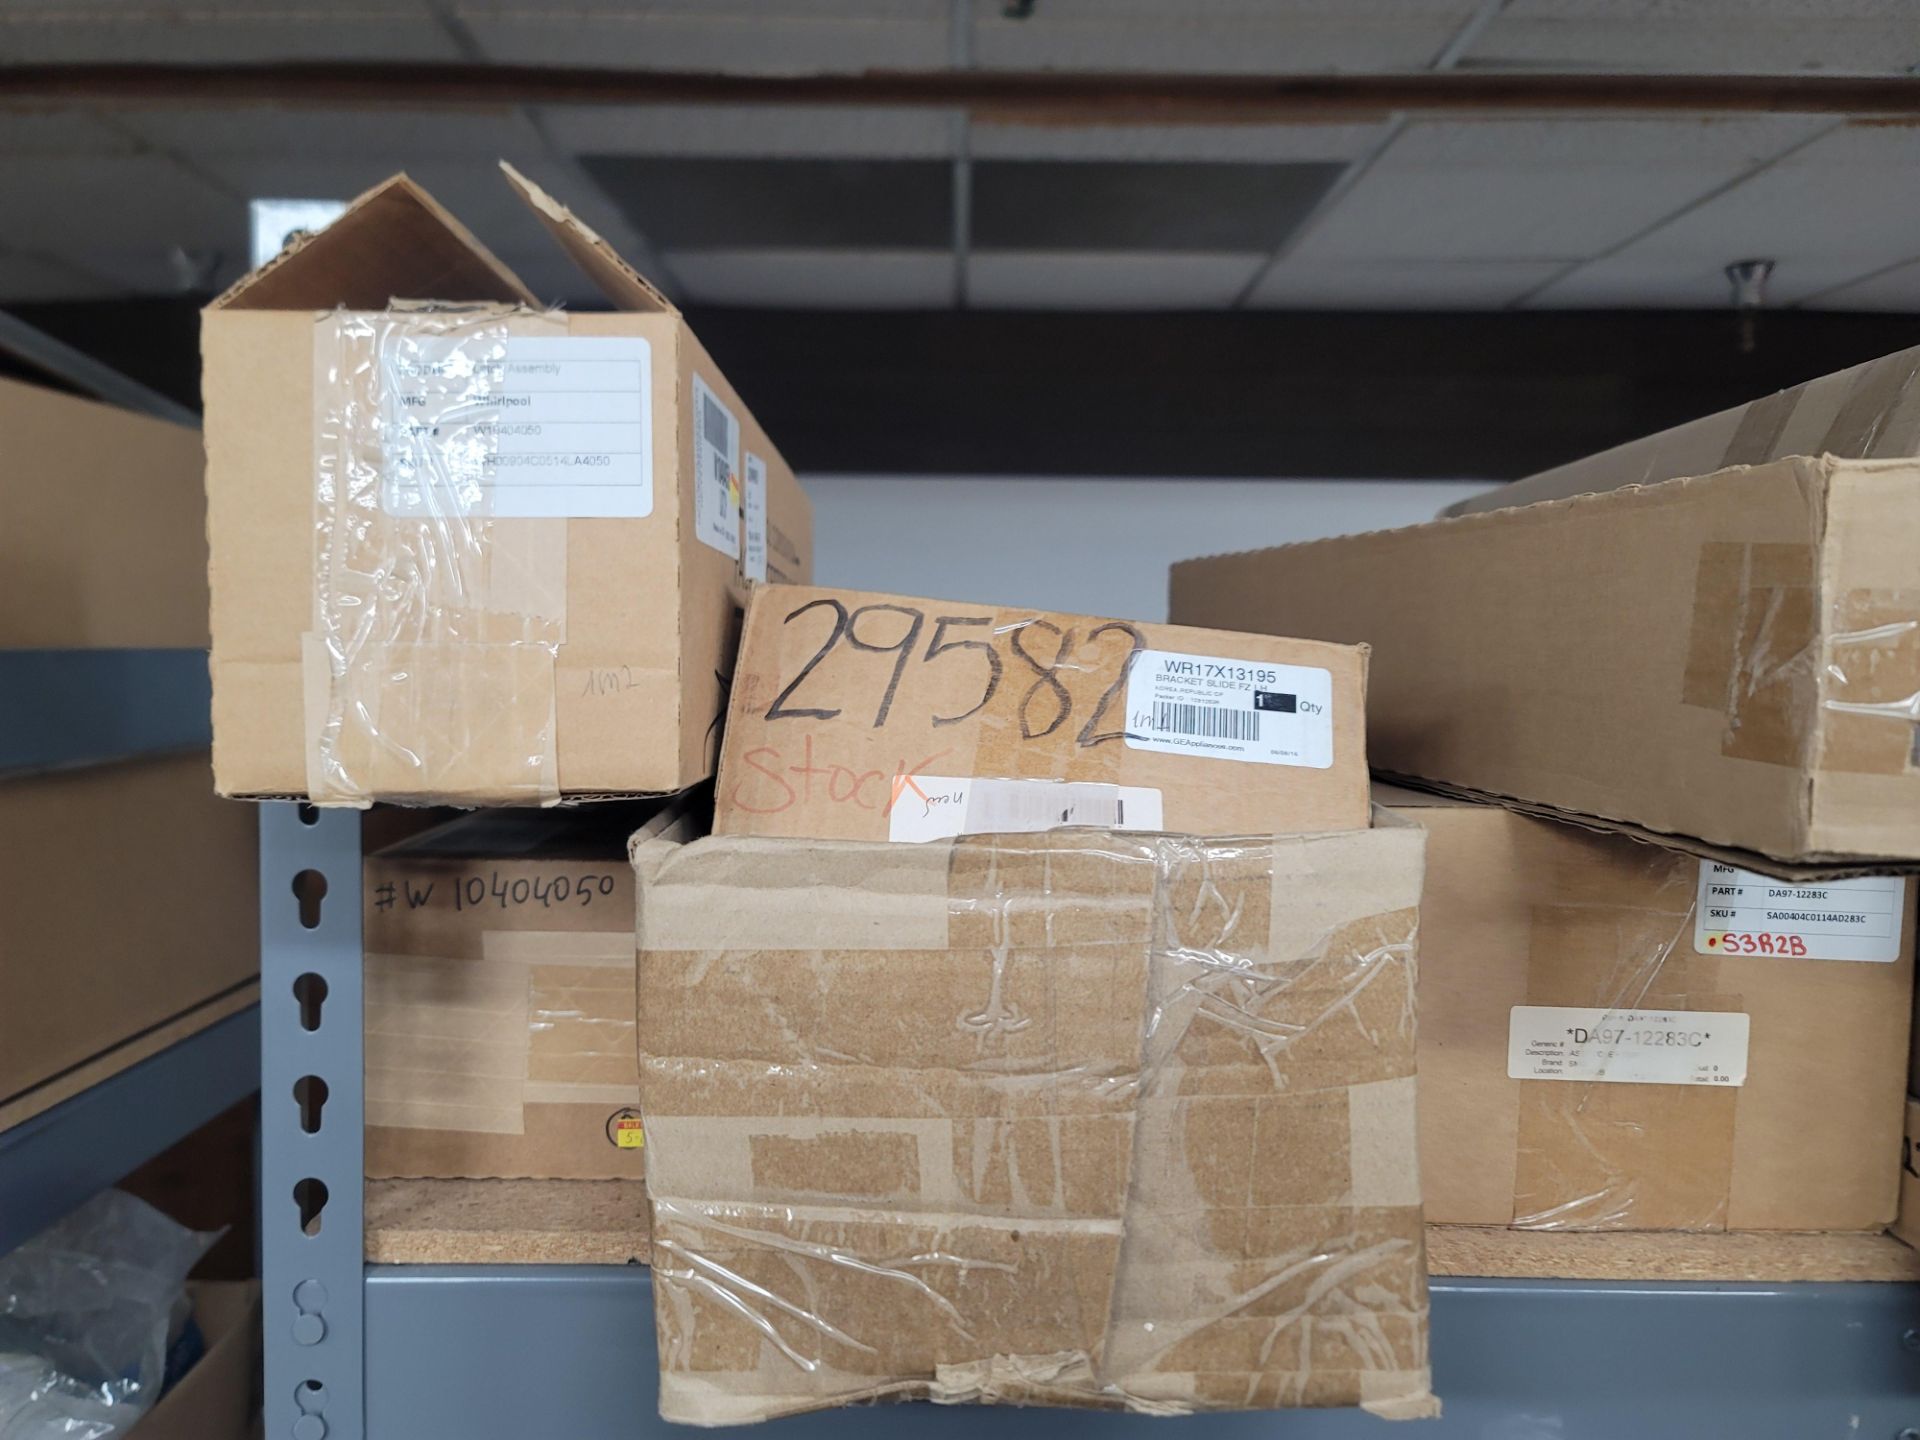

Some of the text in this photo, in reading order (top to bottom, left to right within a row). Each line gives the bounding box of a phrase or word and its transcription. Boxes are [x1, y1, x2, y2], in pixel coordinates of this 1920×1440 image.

[508, 363, 561, 376] Assembly
[474, 395, 531, 408] Whirlpool
[764, 599, 1150, 748] 29582
[1163, 660, 1277, 684] WR17X13195
[1155, 674, 1203, 687] BRACKET
[1206, 678, 1236, 690] SLIDE
[1238, 682, 1251, 692] FZ
[1299, 701, 1323, 715] Qty
[455, 871, 614, 911] 10404050
[1711, 887, 1737, 895] PART
[1768, 889, 1829, 900] DA97-12283C
[1710, 909, 1729, 918] SKU
[1766, 911, 1866, 924] SA00404C0114AD283C
[1721, 932, 1808, 956] S3R2B
